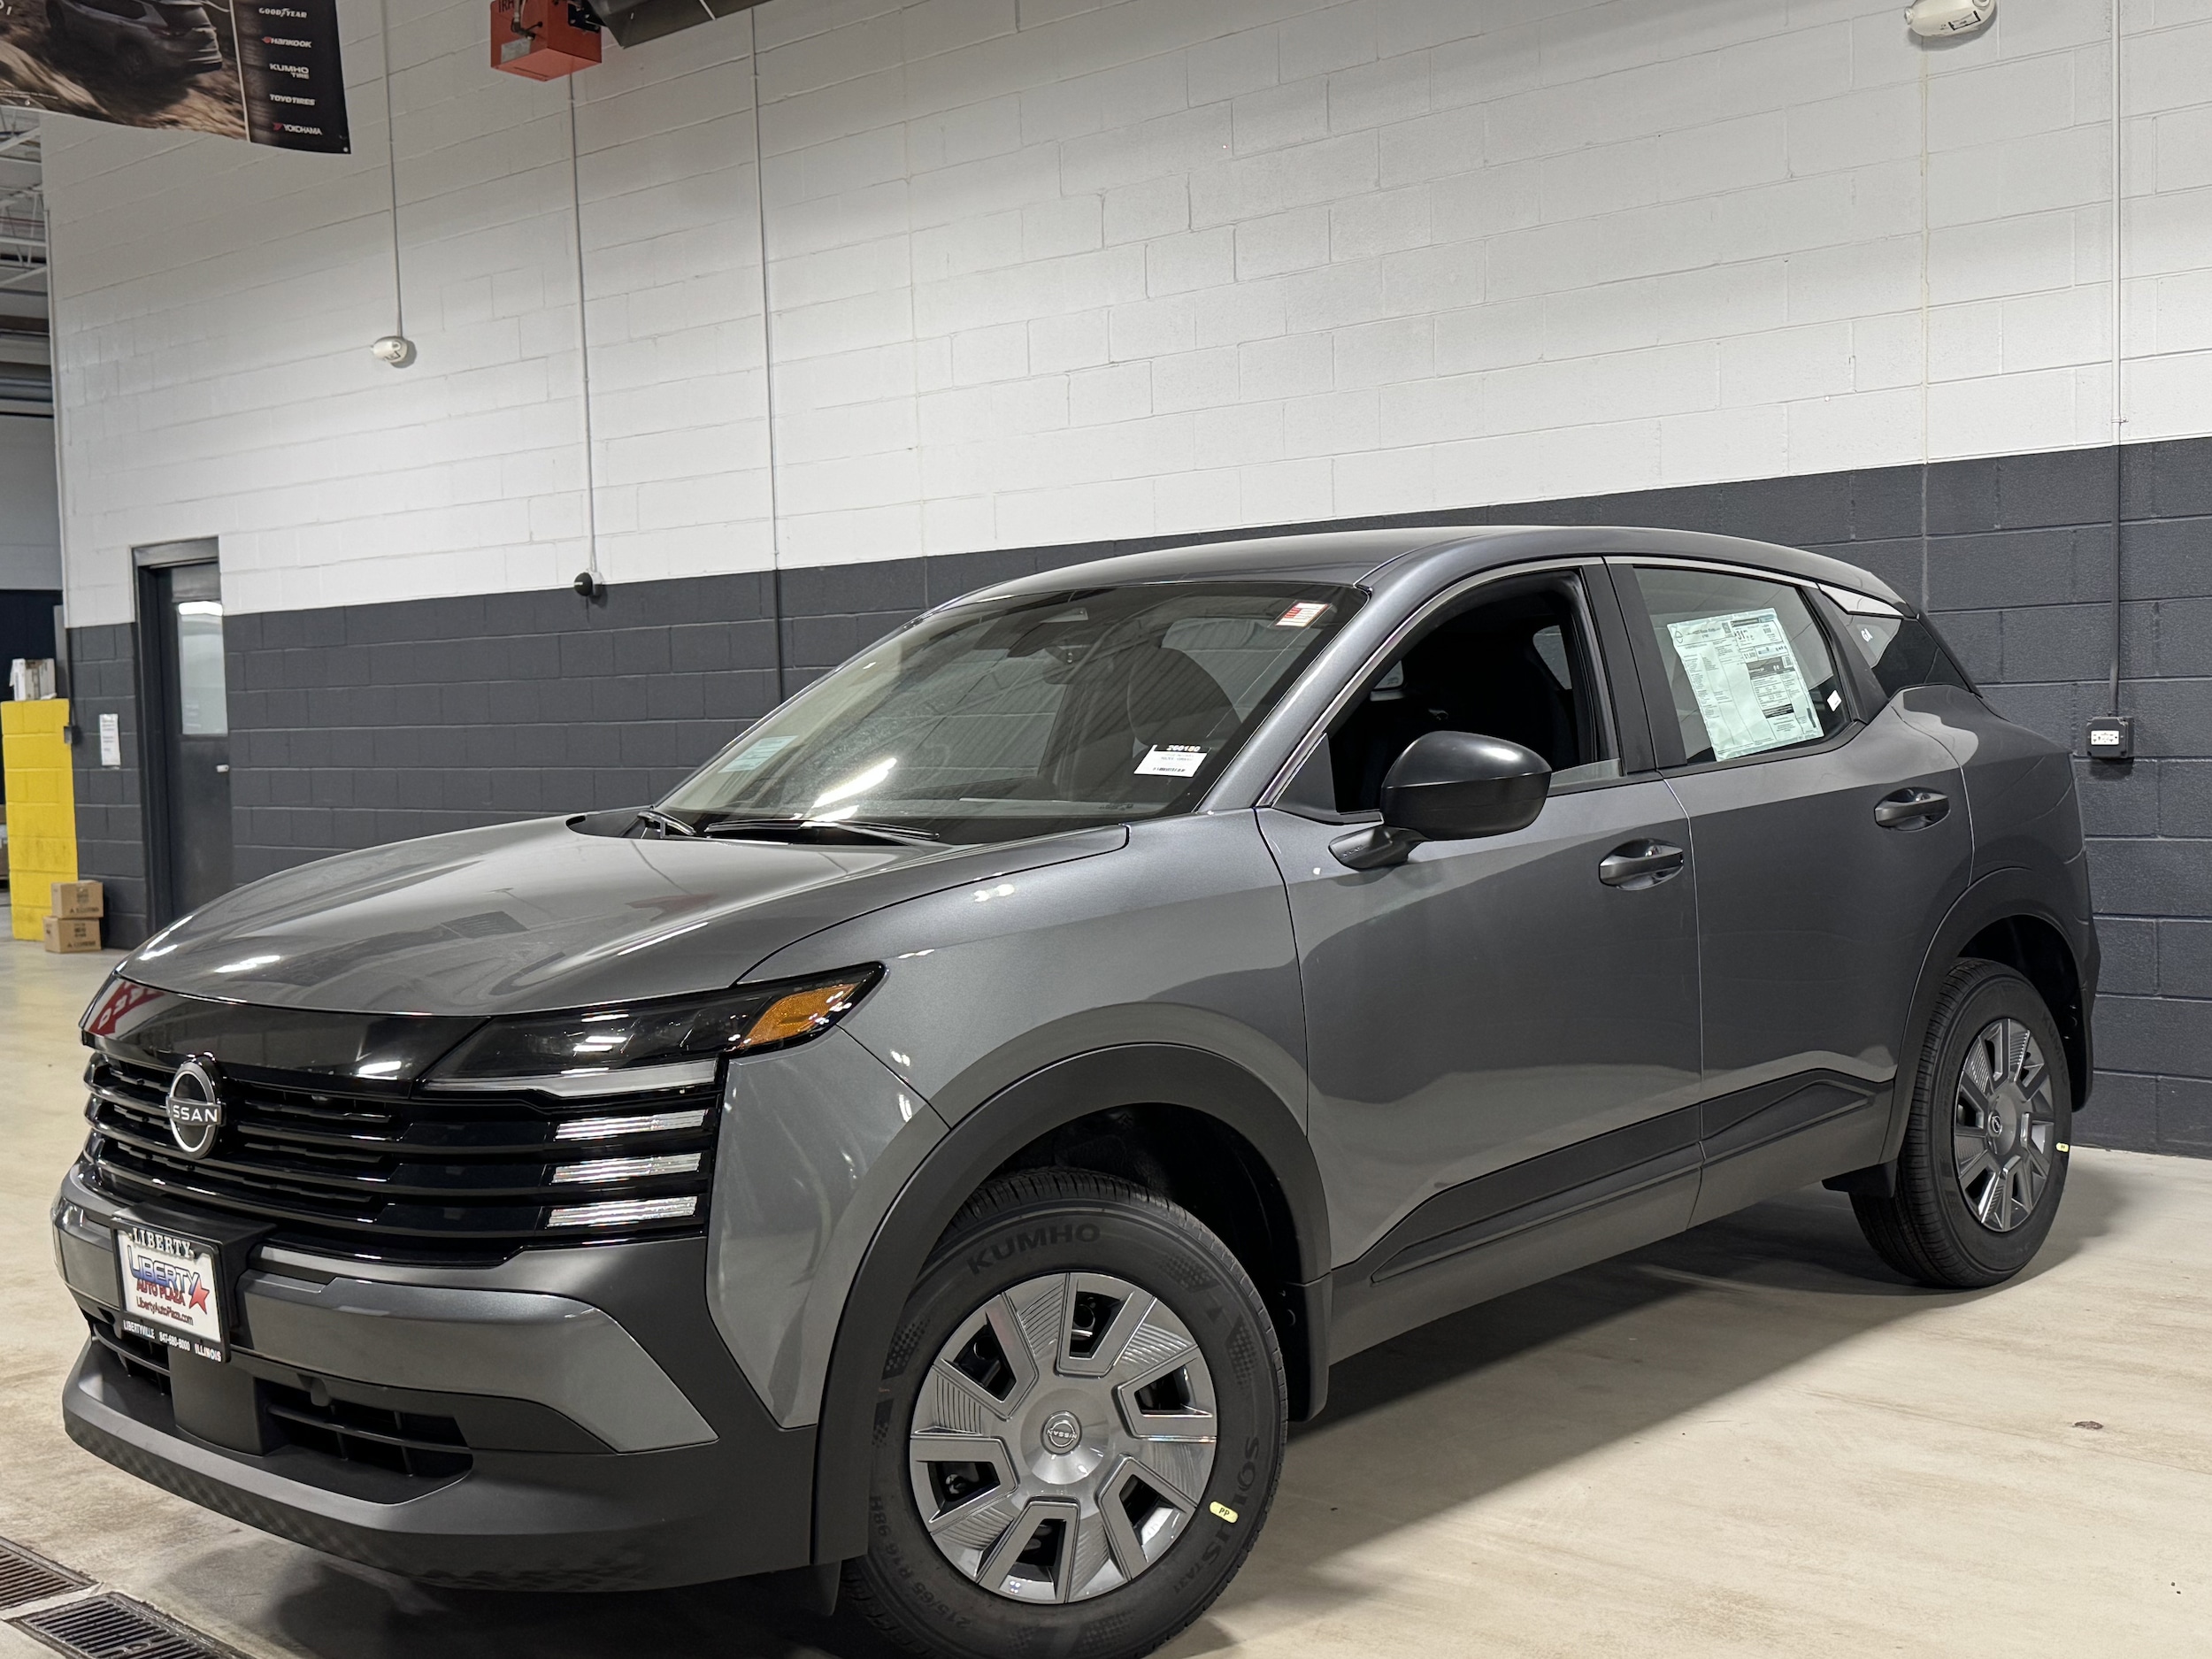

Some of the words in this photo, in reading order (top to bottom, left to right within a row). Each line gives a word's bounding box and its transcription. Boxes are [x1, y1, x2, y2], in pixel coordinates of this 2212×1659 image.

[259, 7, 307, 19] GOODYEAR
[269, 63, 309, 73] KUMHO
[282, 123, 322, 135] YOKOHAMA
[133, 1227, 191, 1259] LIBERTY
[966, 1222, 1101, 1275] KUMHO
[127, 1245, 200, 1296] LIBERTY
[137, 1279, 158, 1297] AUTO
[159, 1285, 186, 1306] PLAZA
[123, 1319, 156, 1340] LIBERTYVILLE
[195, 1343, 222, 1362] ILLINOIS
